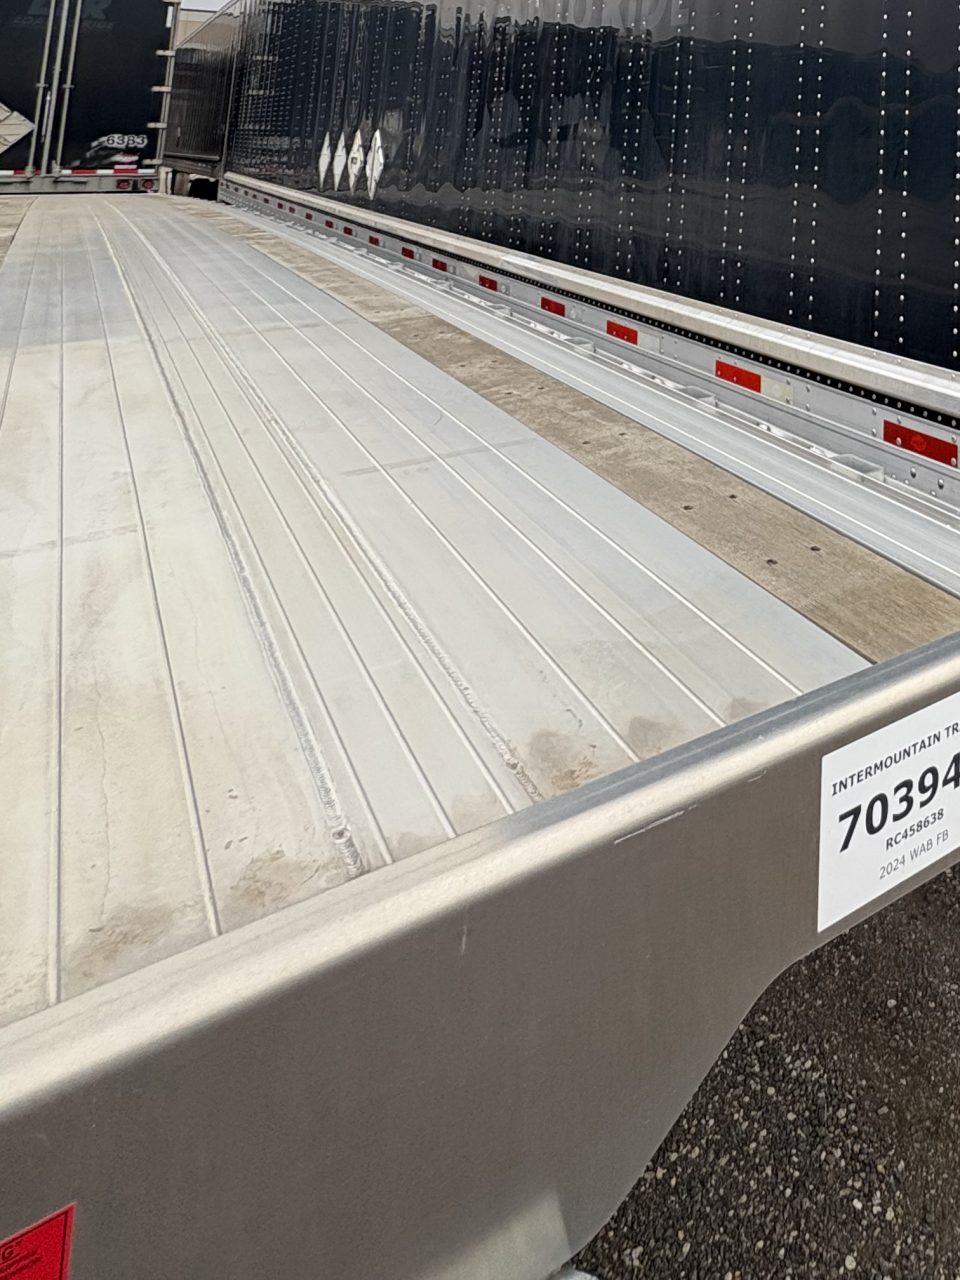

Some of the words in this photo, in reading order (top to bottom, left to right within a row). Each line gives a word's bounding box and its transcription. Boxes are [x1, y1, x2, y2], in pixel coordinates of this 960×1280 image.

[106, 135, 146, 147] 6383
[831, 731, 941, 797] INTERMOUNTAIN
[885, 808, 944, 851] RC458638
[879, 854, 906, 880] 2024
[909, 838, 933, 861] WAB
[936, 828, 949, 846] FB
